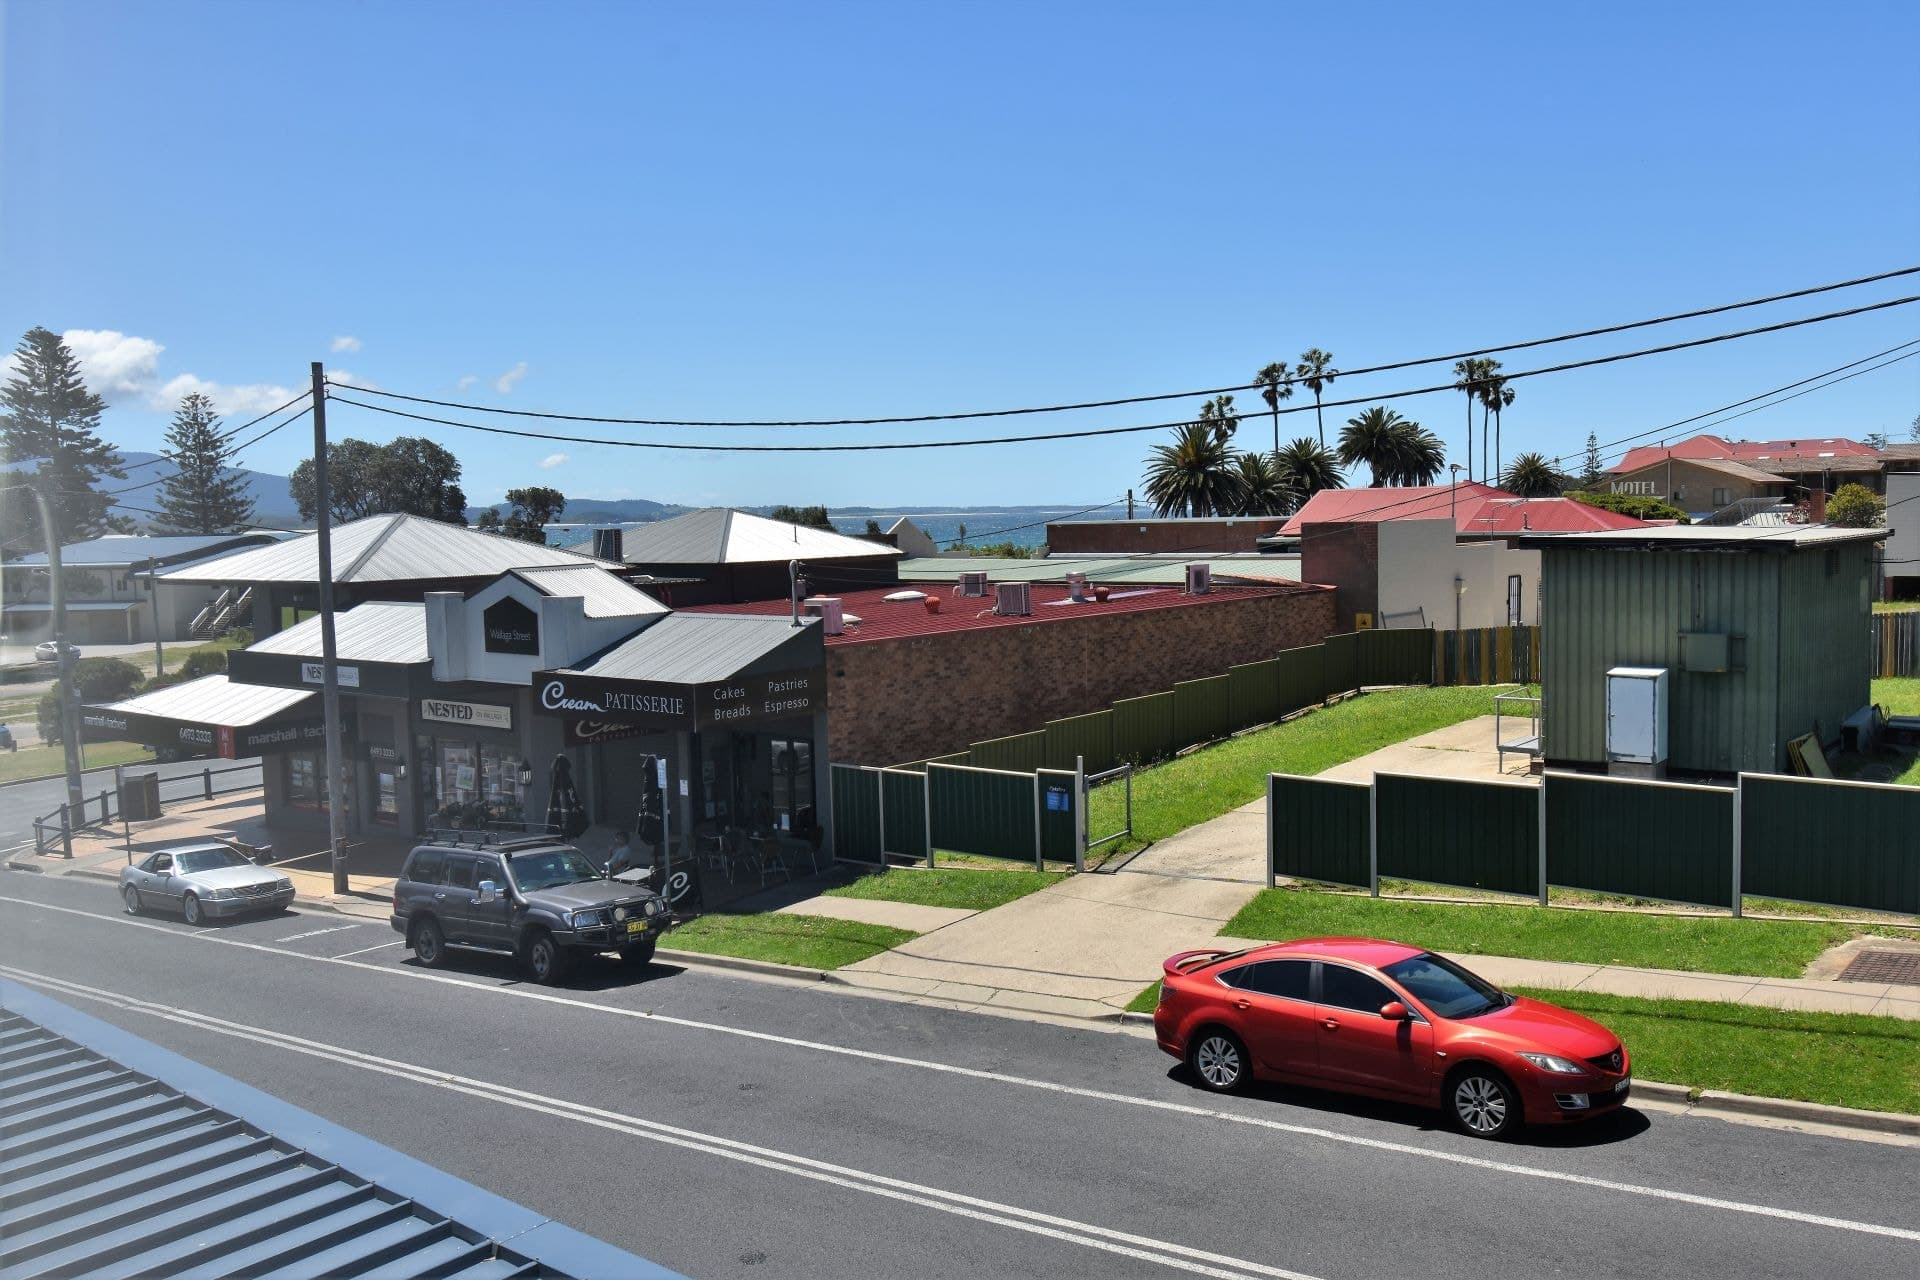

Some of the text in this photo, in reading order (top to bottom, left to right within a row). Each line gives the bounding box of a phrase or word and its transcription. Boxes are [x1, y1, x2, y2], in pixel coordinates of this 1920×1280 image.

[1610, 481, 1656, 495] MOTEL
[713, 687, 746, 700] Cakes
[768, 679, 809, 693] Pastries
[541, 680, 685, 715] Cream PATISSERIE
[427, 701, 473, 720] NESTED
[714, 704, 751, 720] Breads
[764, 698, 810, 714] Espresso
[247, 727, 298, 745] marshall
